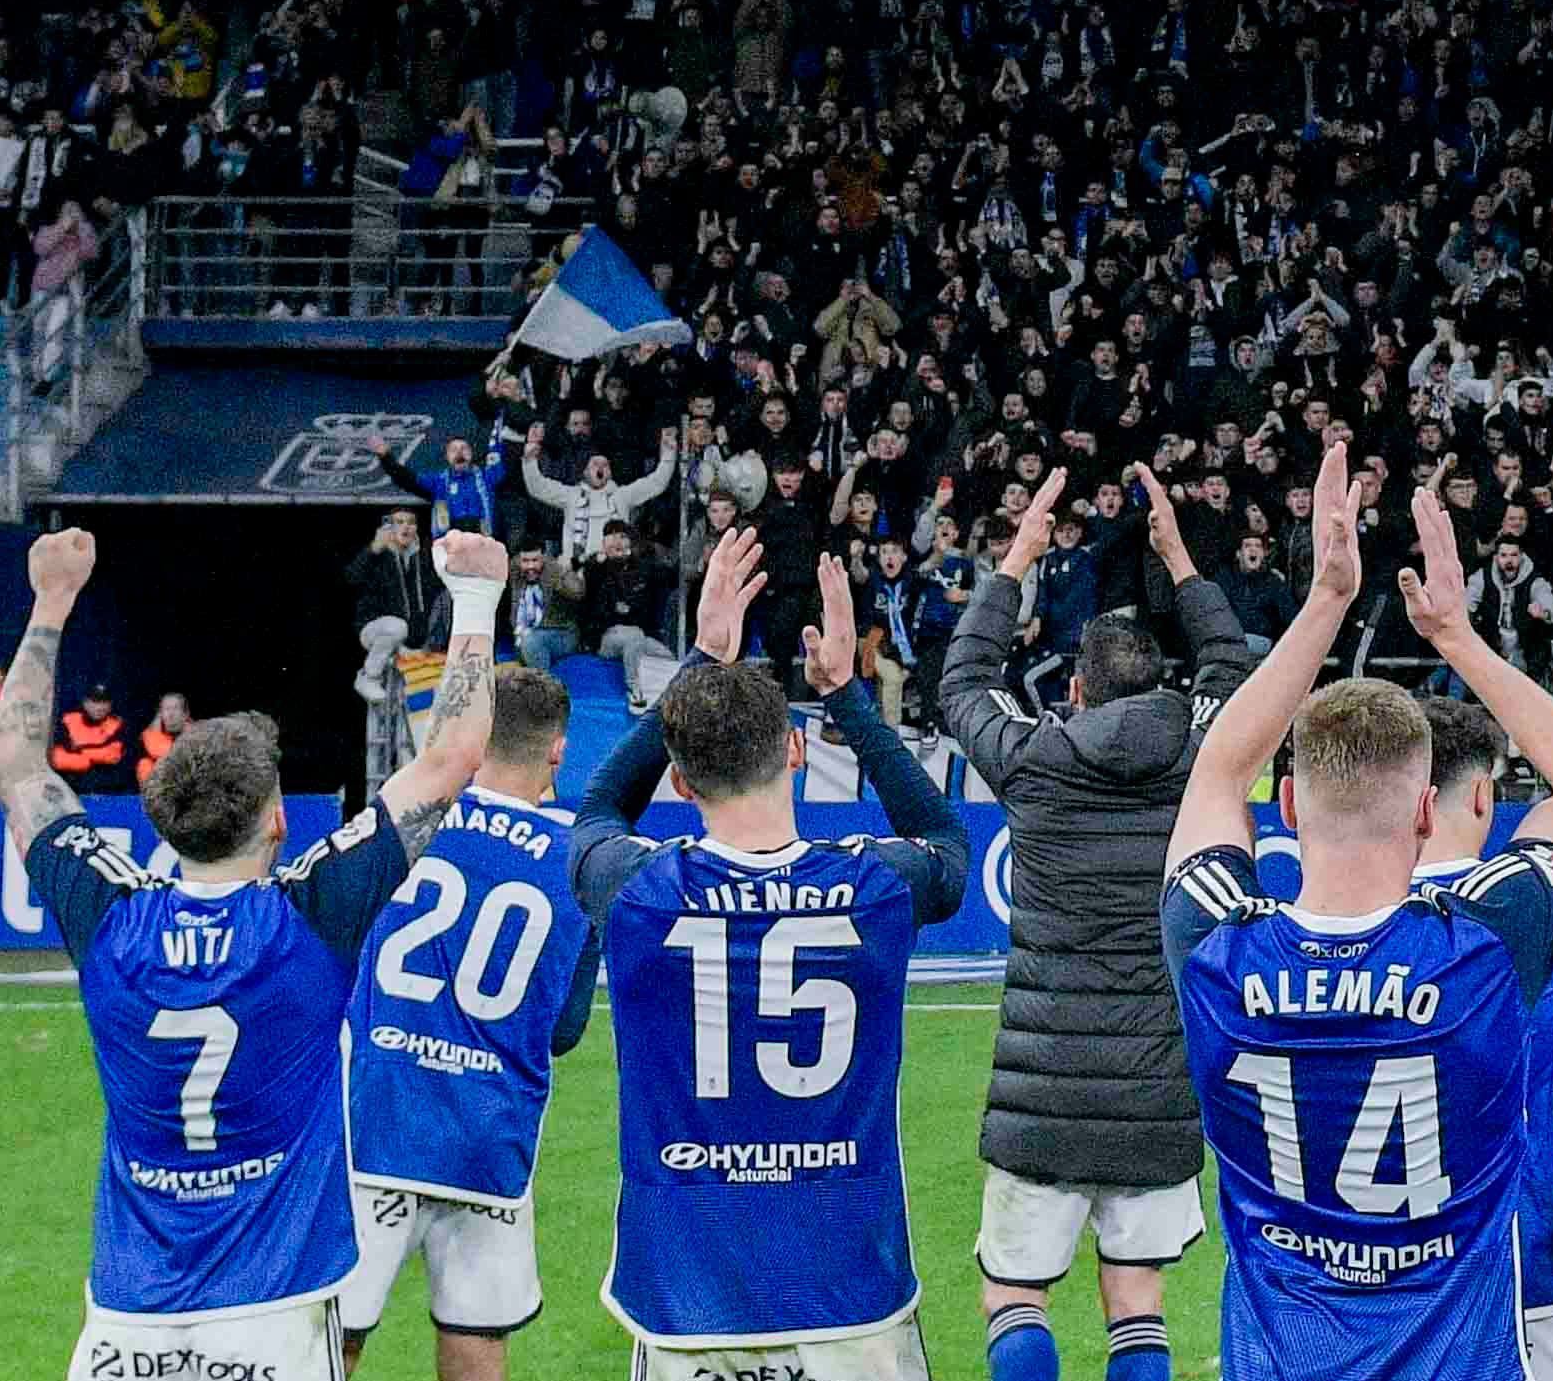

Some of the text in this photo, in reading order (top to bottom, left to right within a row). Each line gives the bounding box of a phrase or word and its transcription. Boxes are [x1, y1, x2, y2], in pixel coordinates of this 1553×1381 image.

[161, 925, 235, 968] VITI
[375, 855, 553, 1021] 20
[662, 914, 864, 1100] 15
[1243, 963, 1441, 1026] ALEMÃO
[147, 1004, 240, 1152] 7
[406, 1032, 505, 1074] HYUNDA
[708, 1140, 858, 1169] HYUNDAI
[1225, 1051, 1452, 1220] 14
[726, 1167, 793, 1183] Asturdai
[1304, 1233, 1456, 1271] HYUNDAI
